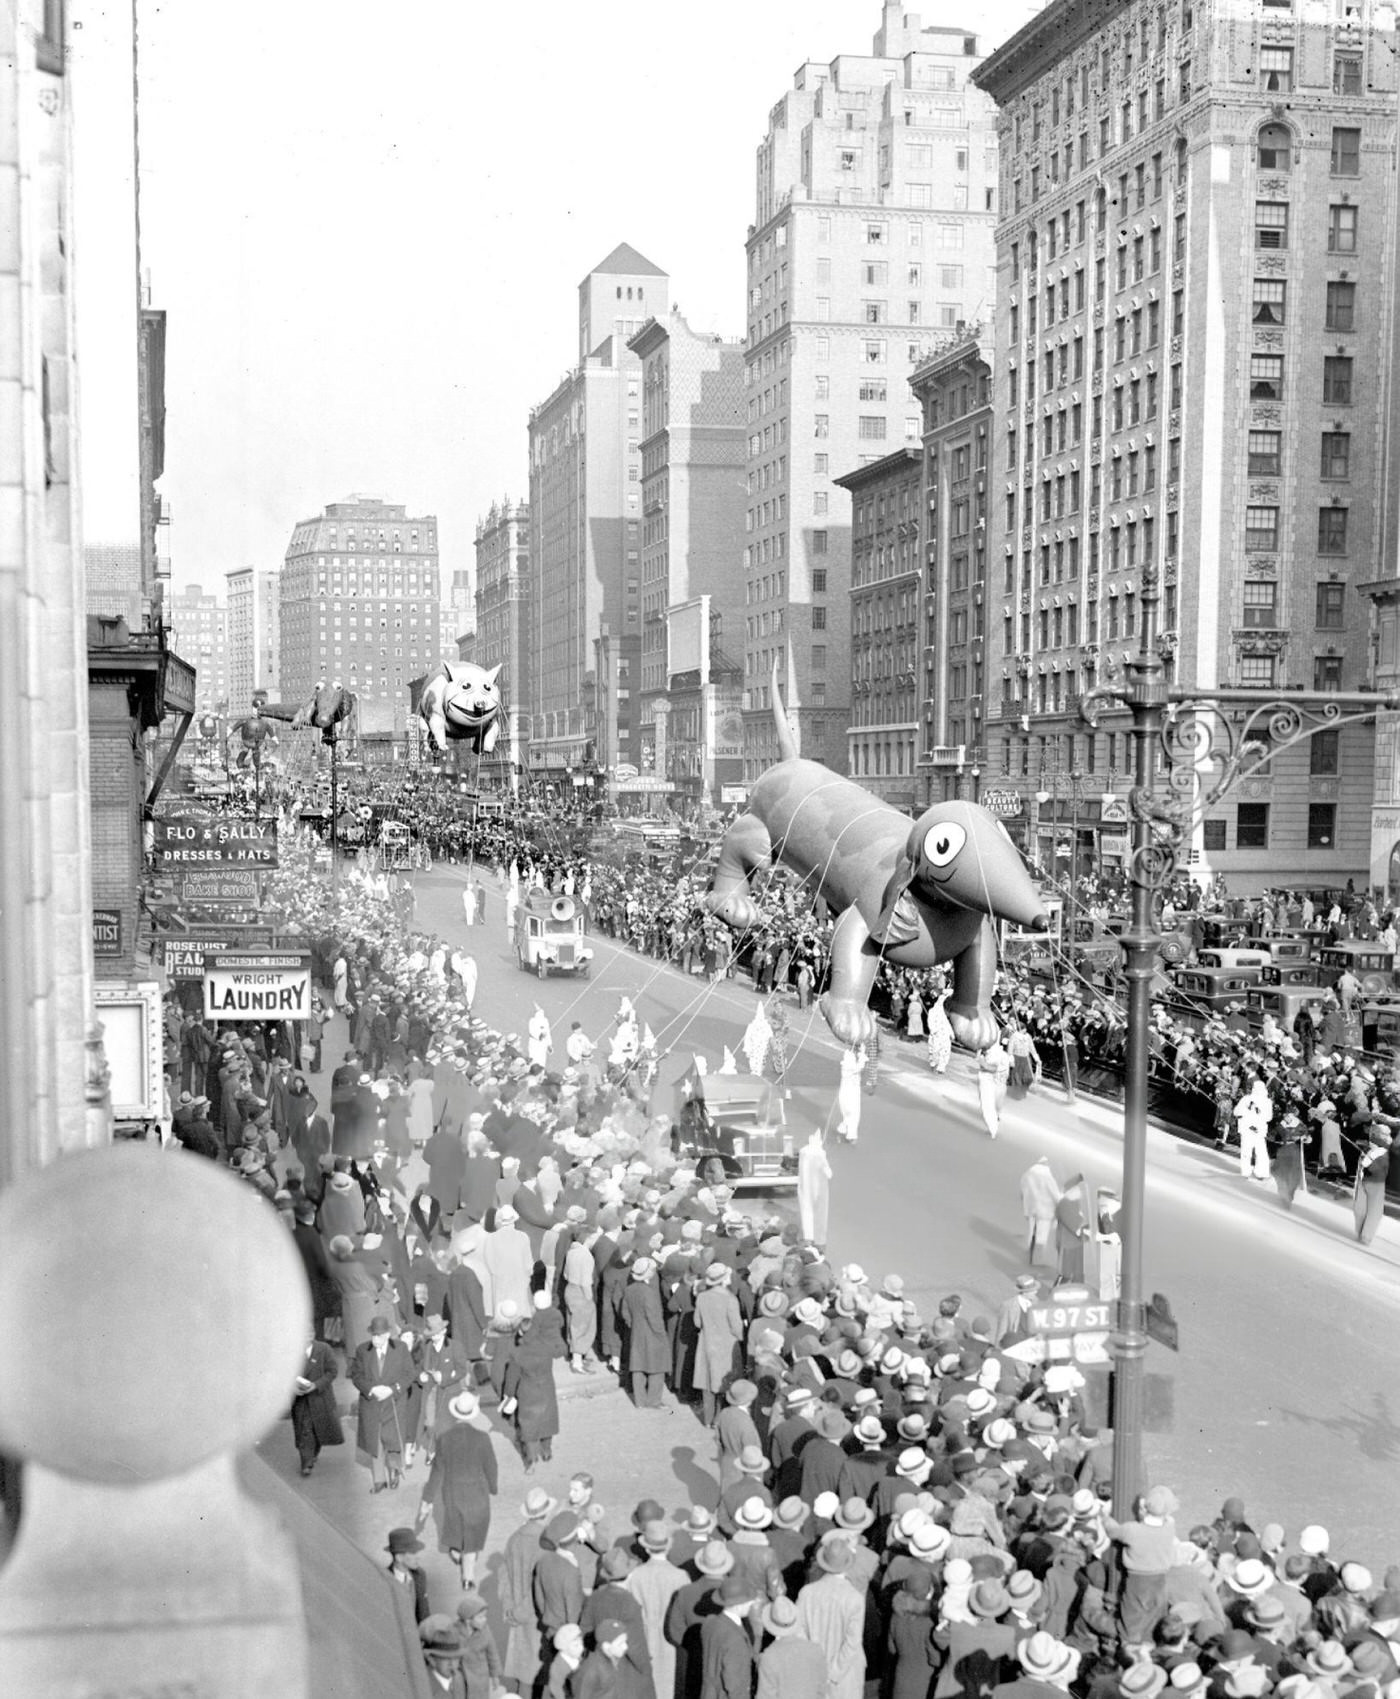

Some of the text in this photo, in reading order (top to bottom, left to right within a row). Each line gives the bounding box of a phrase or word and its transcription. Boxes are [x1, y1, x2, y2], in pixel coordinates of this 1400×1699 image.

[987, 796, 1017, 804] BEAUTY
[166, 826, 266, 840] FLO & SALLY
[164, 850, 222, 861] DRESSES
[238, 850, 271, 860] HATS
[267, 957, 301, 966] FINISH
[232, 974, 284, 984] WRIGHT
[209, 979, 307, 1011] LAUNDRY
[1052, 1307, 1081, 1328] 97
[1084, 1305, 1110, 1327] ST
